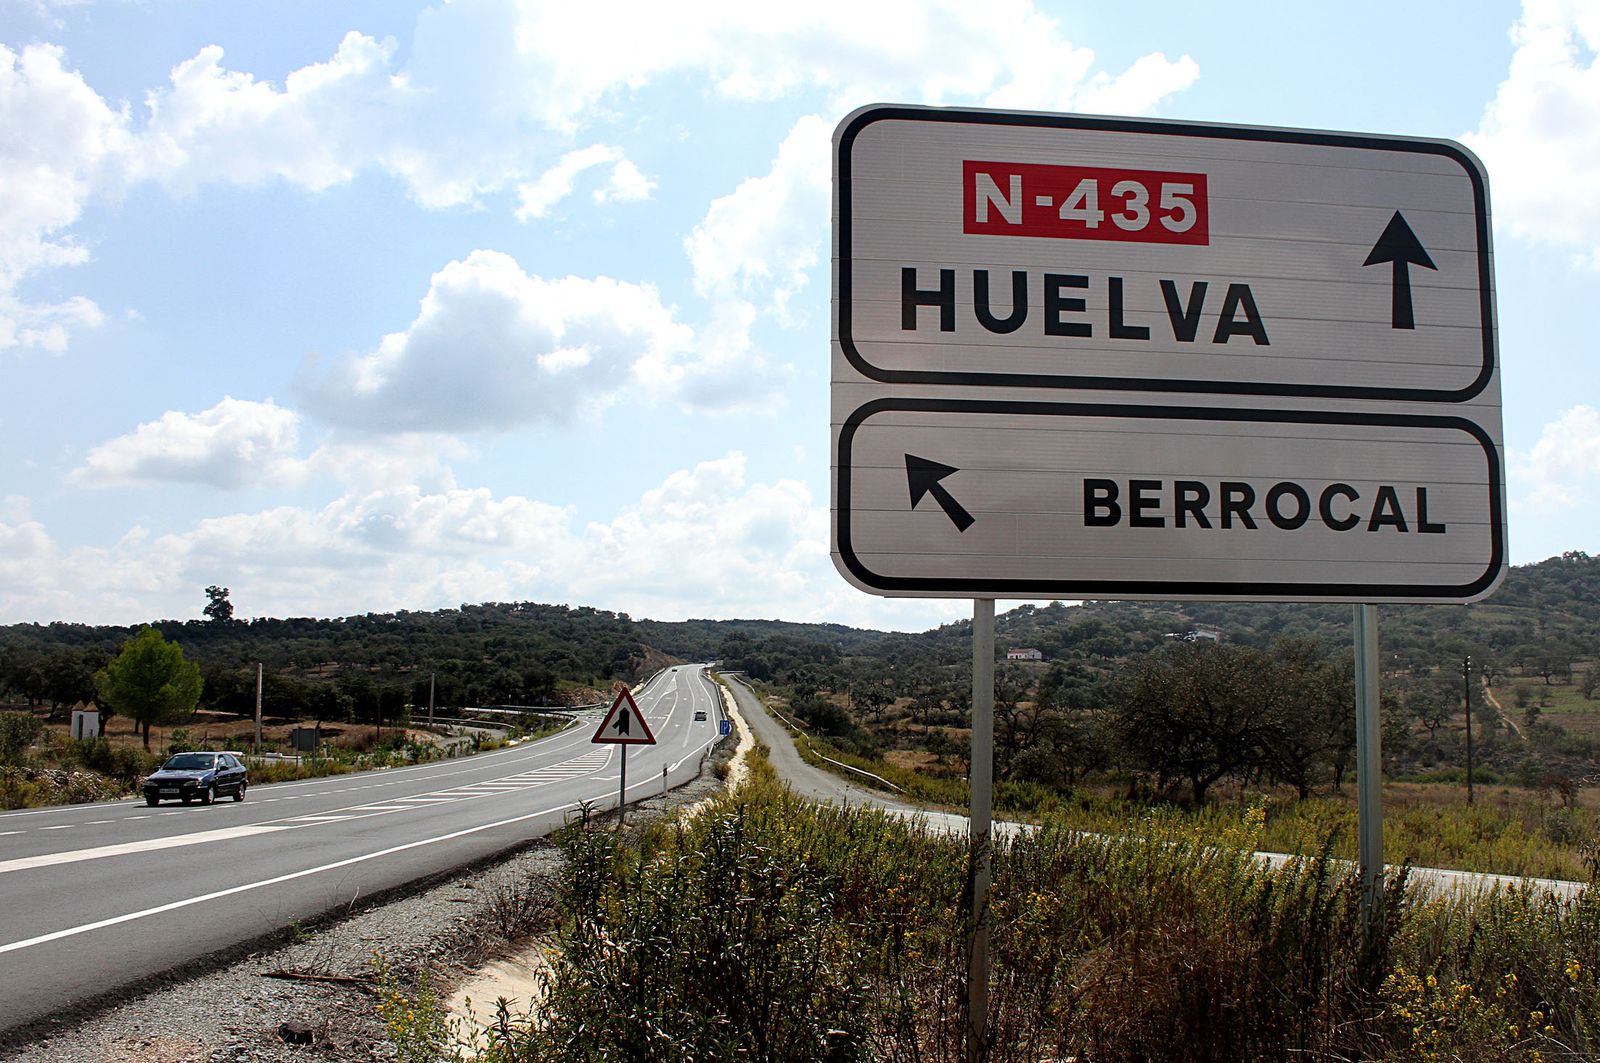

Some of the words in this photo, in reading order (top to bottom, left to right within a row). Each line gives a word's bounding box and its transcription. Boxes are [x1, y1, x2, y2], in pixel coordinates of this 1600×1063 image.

[974, 172, 1198, 234] N-435
[901, 267, 1271, 346] HUELVA
[1083, 478, 1446, 534] BERROCAL
